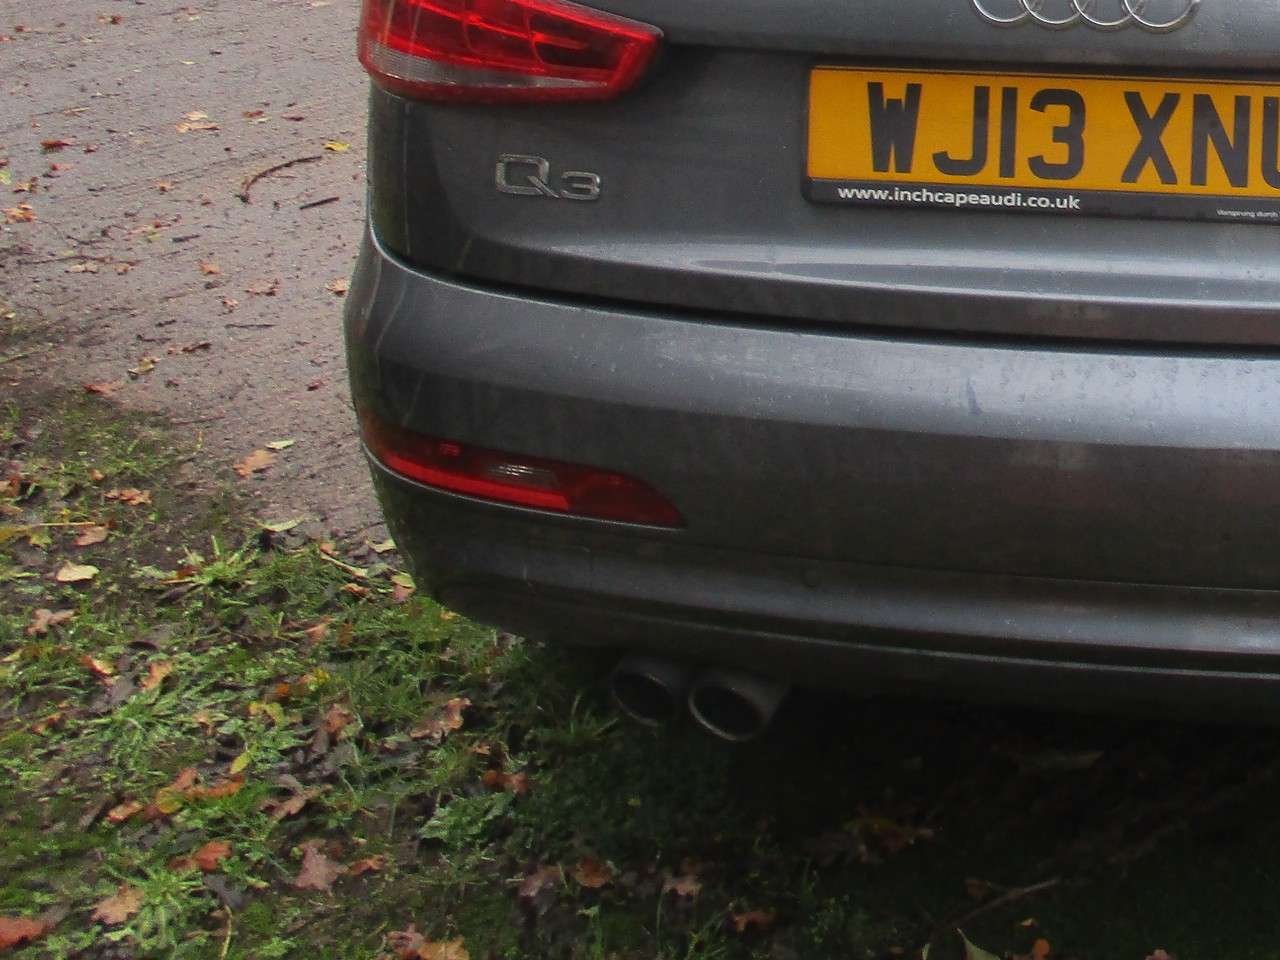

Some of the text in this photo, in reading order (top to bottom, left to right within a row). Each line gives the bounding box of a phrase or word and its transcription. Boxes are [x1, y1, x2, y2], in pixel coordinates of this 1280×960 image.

[866, 81, 1087, 182] WJ13
[494, 152, 602, 201] Q3
[837, 186, 1081, 210] www.inchcapeaudi.co.uk
